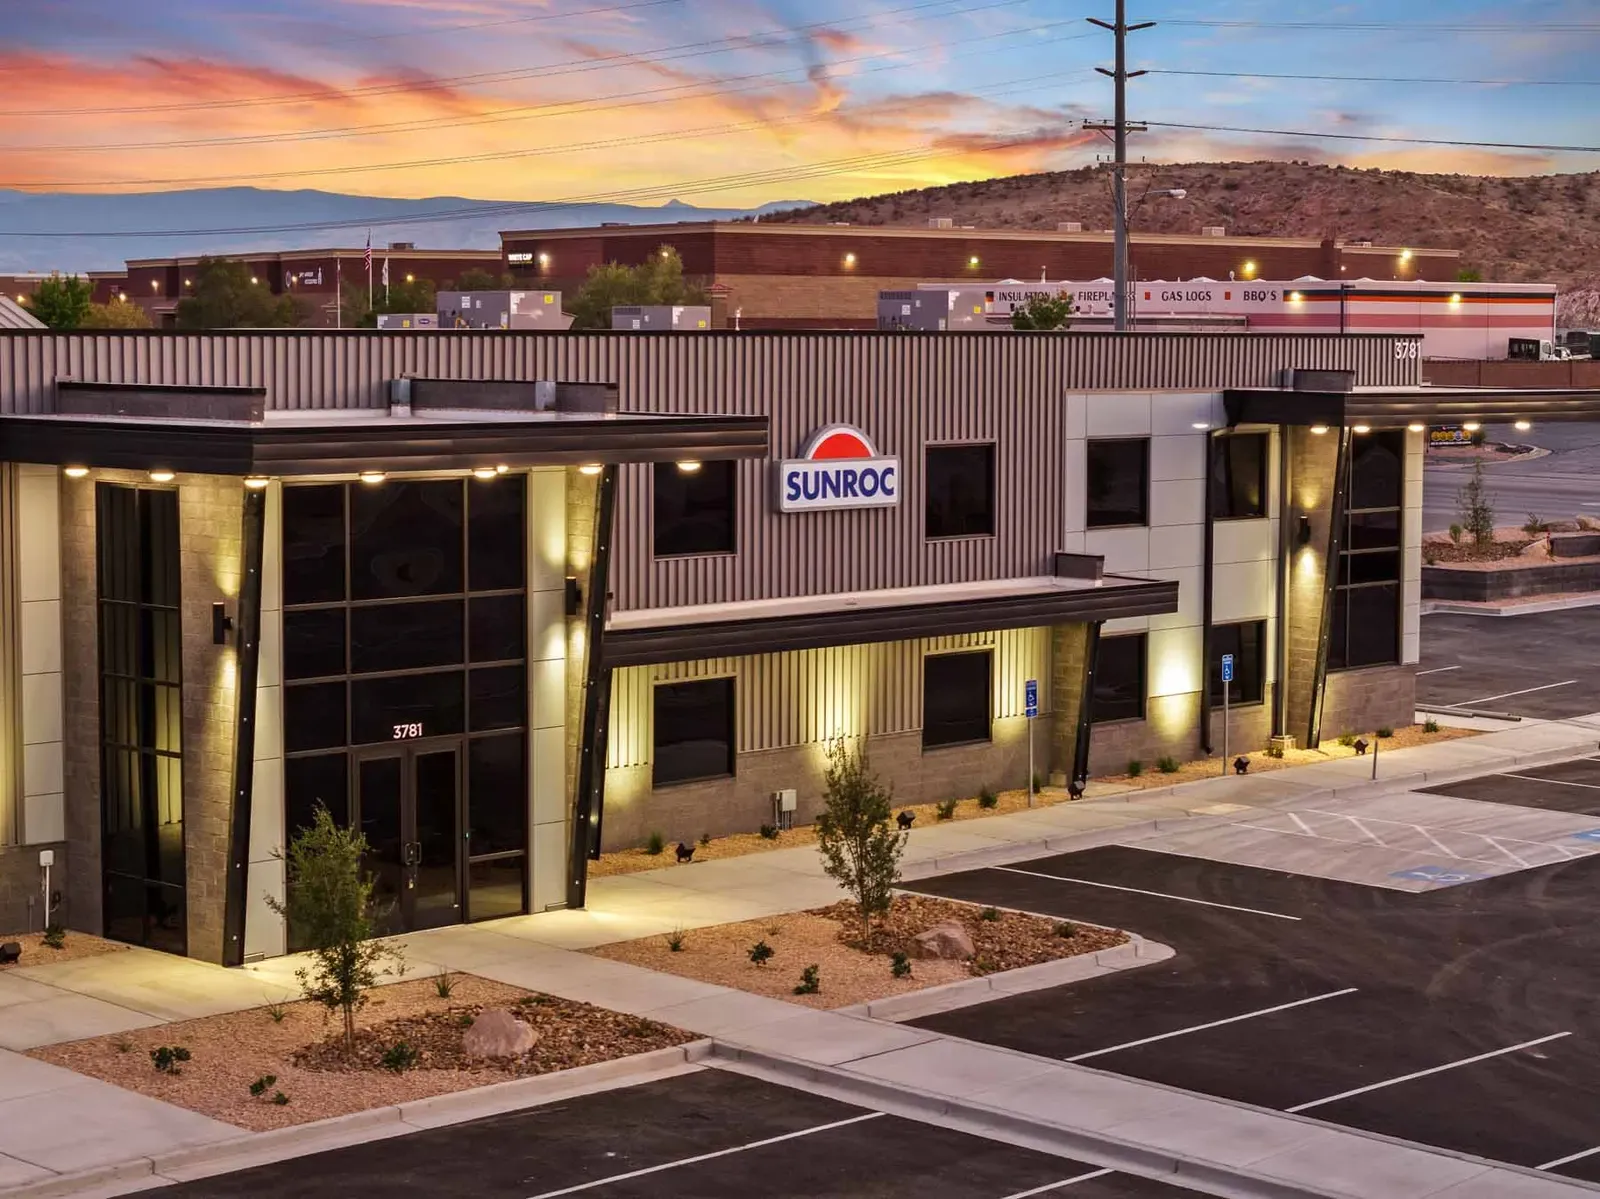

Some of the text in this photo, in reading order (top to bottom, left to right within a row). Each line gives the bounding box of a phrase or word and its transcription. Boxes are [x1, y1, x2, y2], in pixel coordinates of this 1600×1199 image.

[1161, 291, 1183, 301] GAS
[1185, 290, 1212, 301] LOGS
[1243, 290, 1277, 302] BBQ'S
[1394, 341, 1421, 359] 3781
[786, 467, 895, 502] SUNROC
[393, 722, 422, 739] 3781
